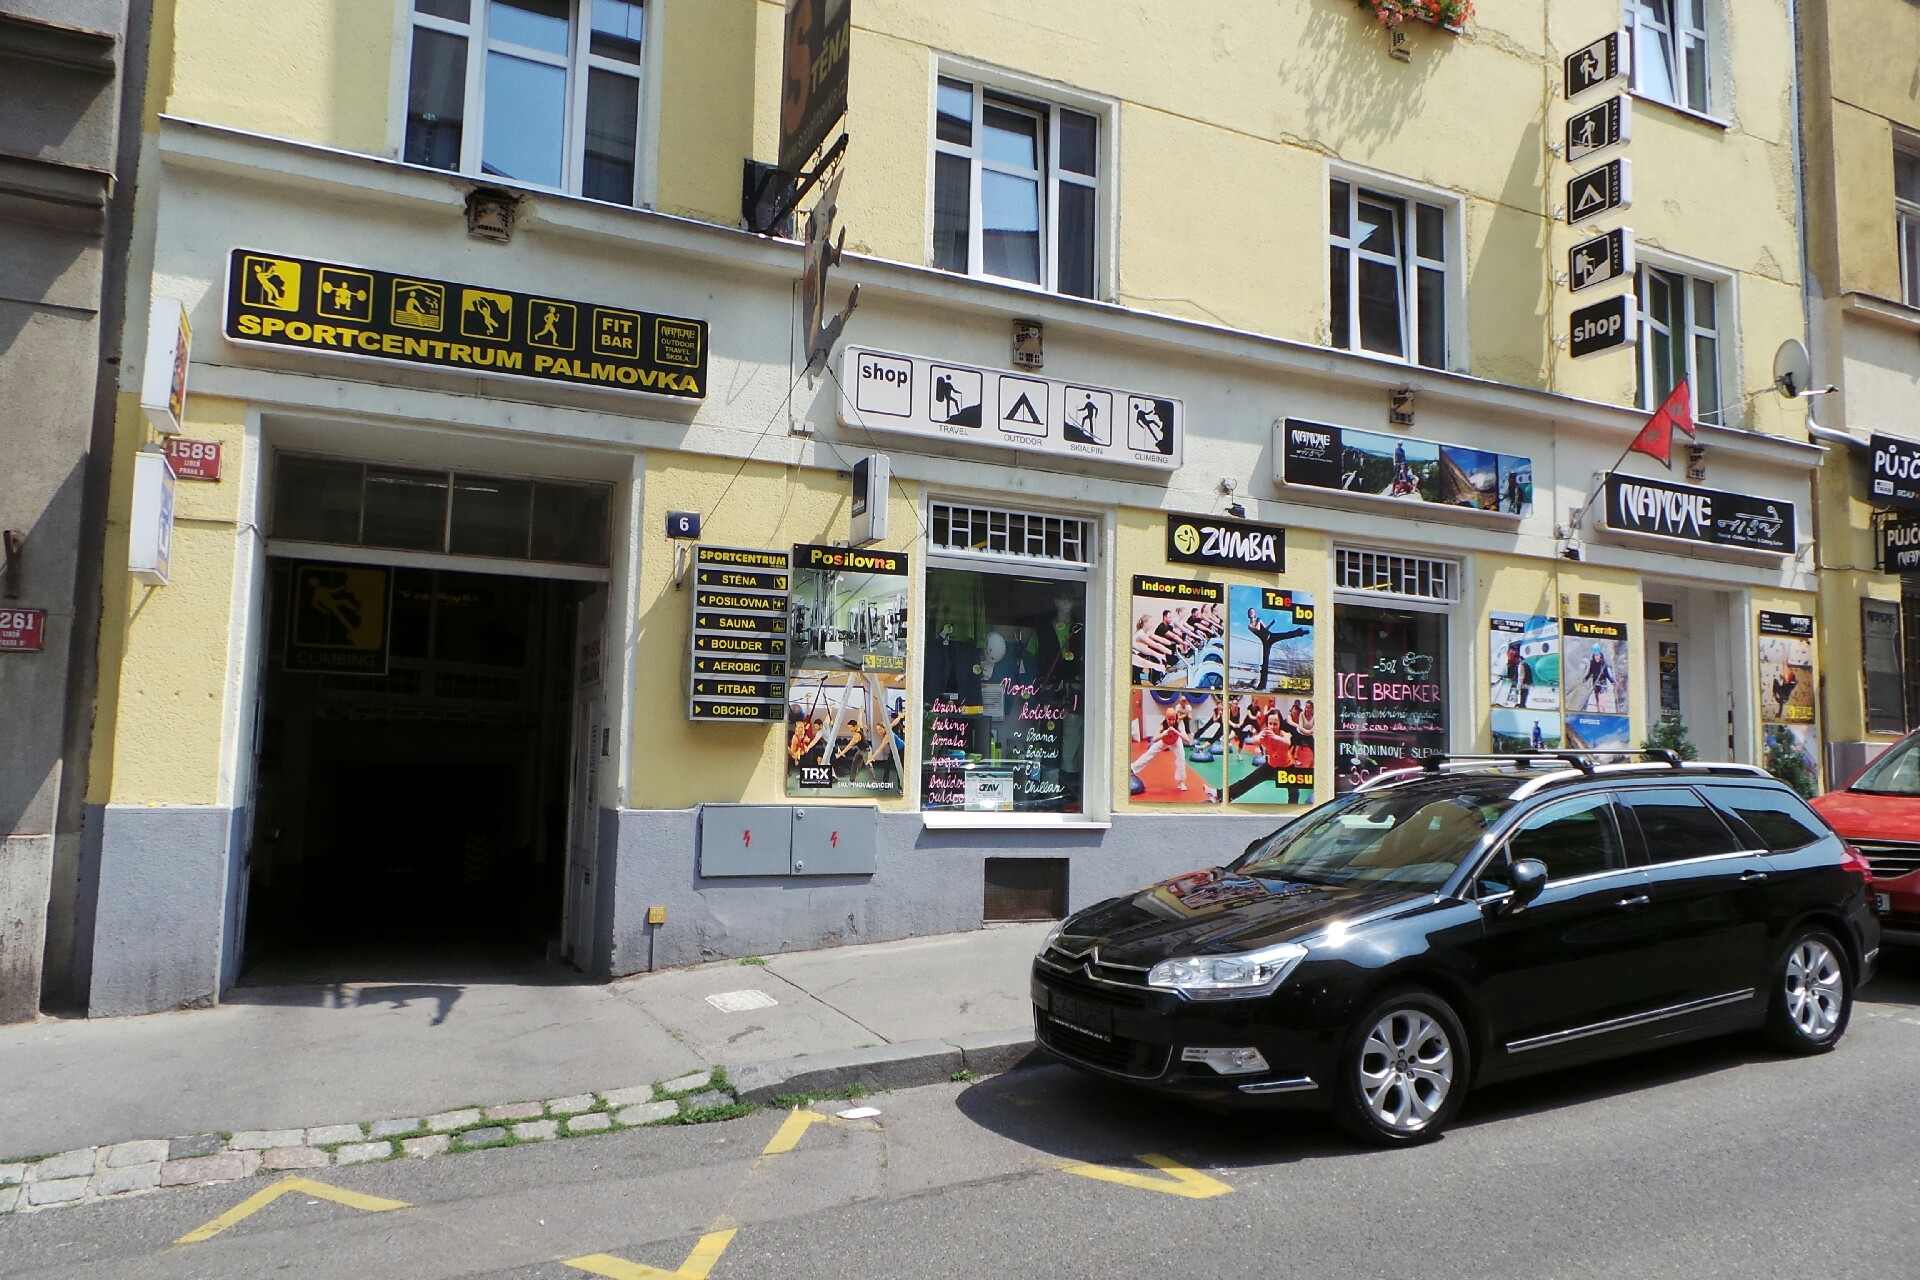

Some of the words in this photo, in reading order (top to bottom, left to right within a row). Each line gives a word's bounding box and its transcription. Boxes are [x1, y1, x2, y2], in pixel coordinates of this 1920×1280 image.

[602, 317, 632, 334] FIT
[1573, 313, 1621, 342] shop
[601, 334, 632, 349] BAR
[661, 338, 695, 349] OUTDOOR
[237, 314, 522, 370] SPORTCENTRUM
[534, 354, 699, 393] PALMOVKA
[665, 346, 690, 355] TRAVEL
[862, 362, 908, 388] shop
[938, 424, 968, 436] TRAVEL
[1004, 434, 1043, 447] OUTDOOR
[170, 441, 216, 460] 1589
[1070, 443, 1104, 456] SKIALPIN
[1135, 452, 1168, 465] CLIMBING
[679, 516, 689, 532] 6
[1887, 524, 1920, 547] PŮJČ
[1200, 526, 1276, 563] ZUMBA
[700, 550, 786, 566] SPORTCENTRUM
[811, 549, 896, 571] Posilovna
[1141, 580, 1177, 594] Indoor
[1178, 585, 1217, 599] Rowing
[708, 596, 770, 609] POSILOVNA
[1266, 592, 1292, 607] Tae
[1296, 606, 1313, 620] bo
[0, 612, 34, 630] 261
[719, 618, 756, 629] SAUNA
[1574, 622, 1589, 634] Via
[1590, 624, 1618, 636] Ferata
[711, 639, 763, 651] BOULDER
[298, 651, 376, 667] CLIMBING
[713, 661, 761, 673] AEROBIC
[717, 684, 756, 695] FITBAR
[1337, 672, 1369, 701] ICE
[1373, 683, 1441, 703] BREAKER
[712, 705, 759, 716] OBCHOD
[1342, 722, 1360, 730] HOT
[801, 767, 829, 780] TRX
[1277, 769, 1313, 786] Bosu
